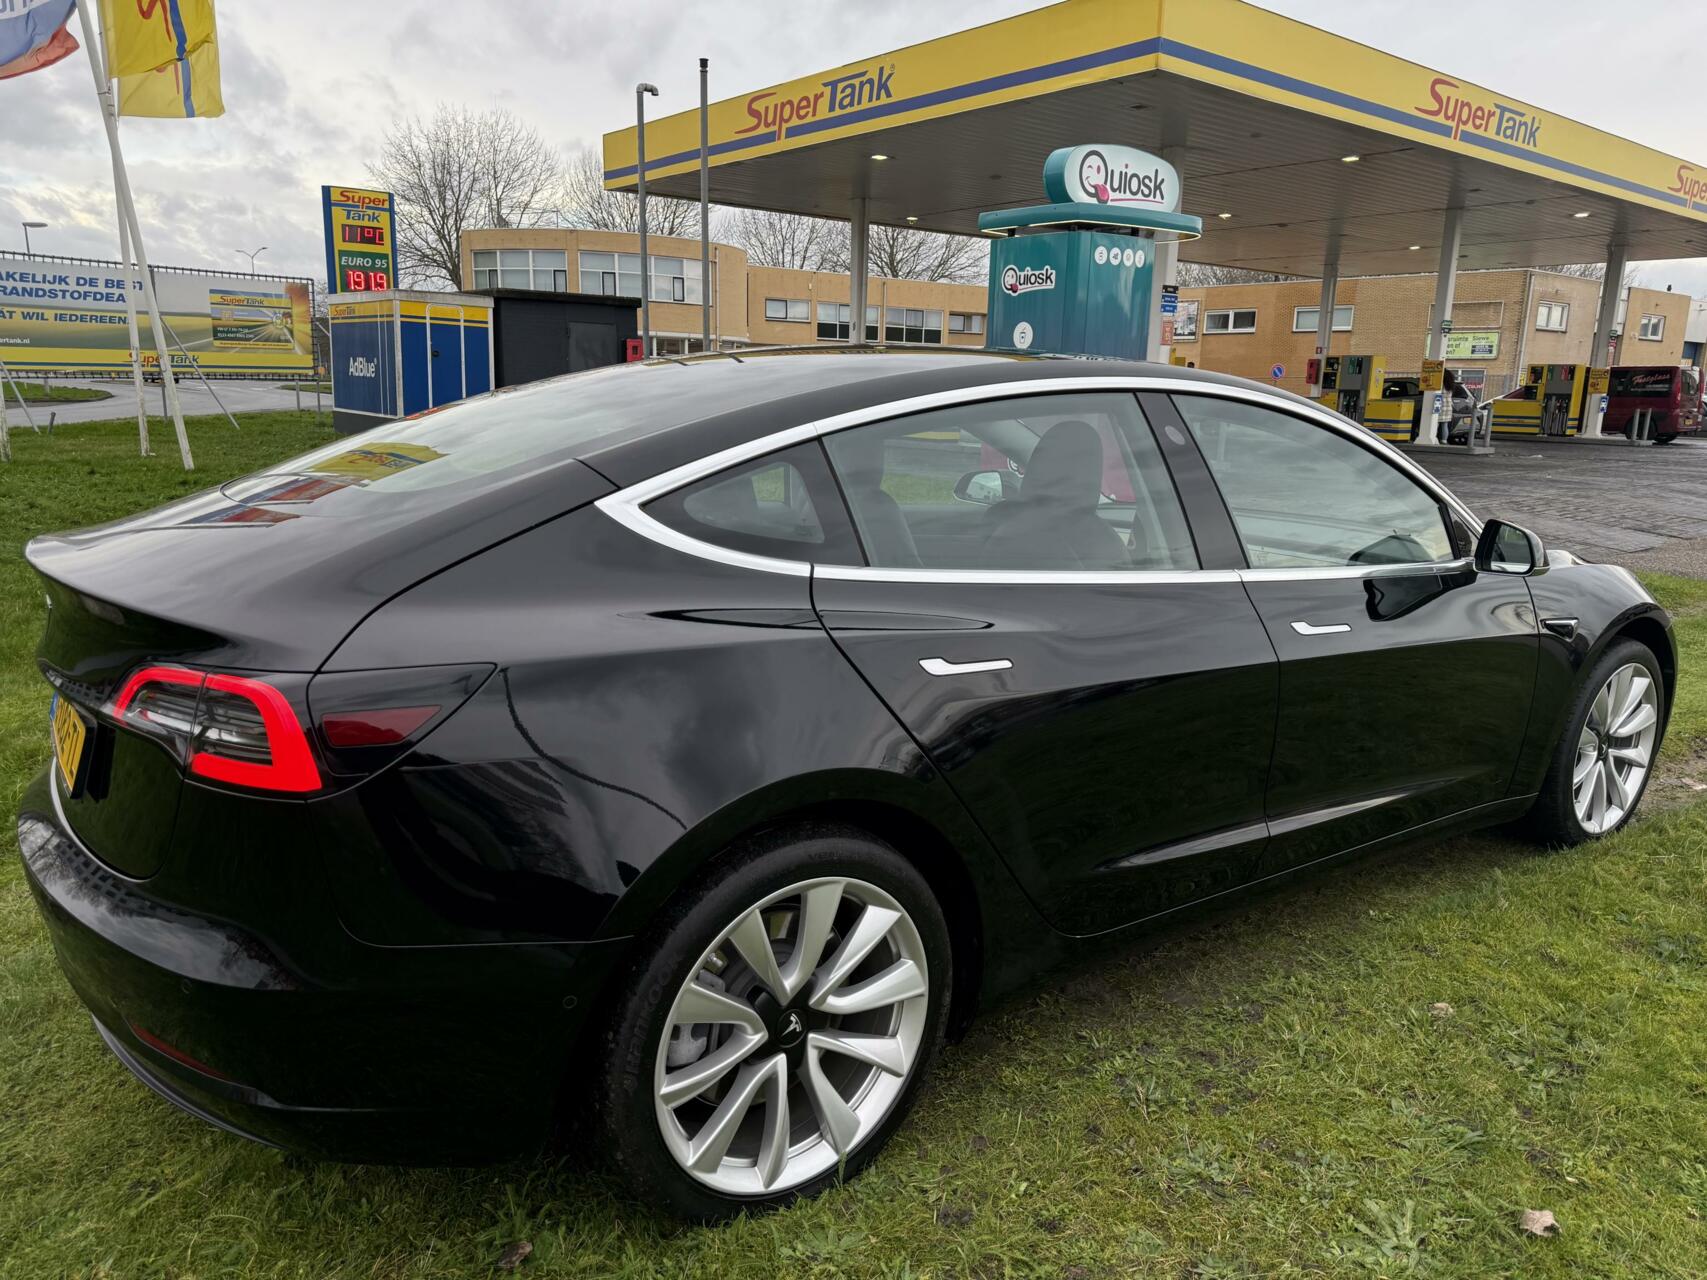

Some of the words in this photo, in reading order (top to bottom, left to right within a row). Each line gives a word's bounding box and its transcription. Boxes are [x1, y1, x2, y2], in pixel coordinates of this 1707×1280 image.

[734, 63, 895, 141] SuperTank
[1415, 77, 1541, 148] SuperTank
[1078, 149, 1165, 205] Quiosk
[1667, 164, 1707, 209] Supe
[333, 190, 388, 209] Super
[341, 208, 381, 223] Tank
[341, 256, 372, 267] EURO
[375, 259, 388, 268] 95
[76, 277, 99, 287] DE
[1003, 266, 1054, 294] Quiosk
[0, 285, 126, 303] RANDSTOFDEA
[21, 311, 49, 321] WIL
